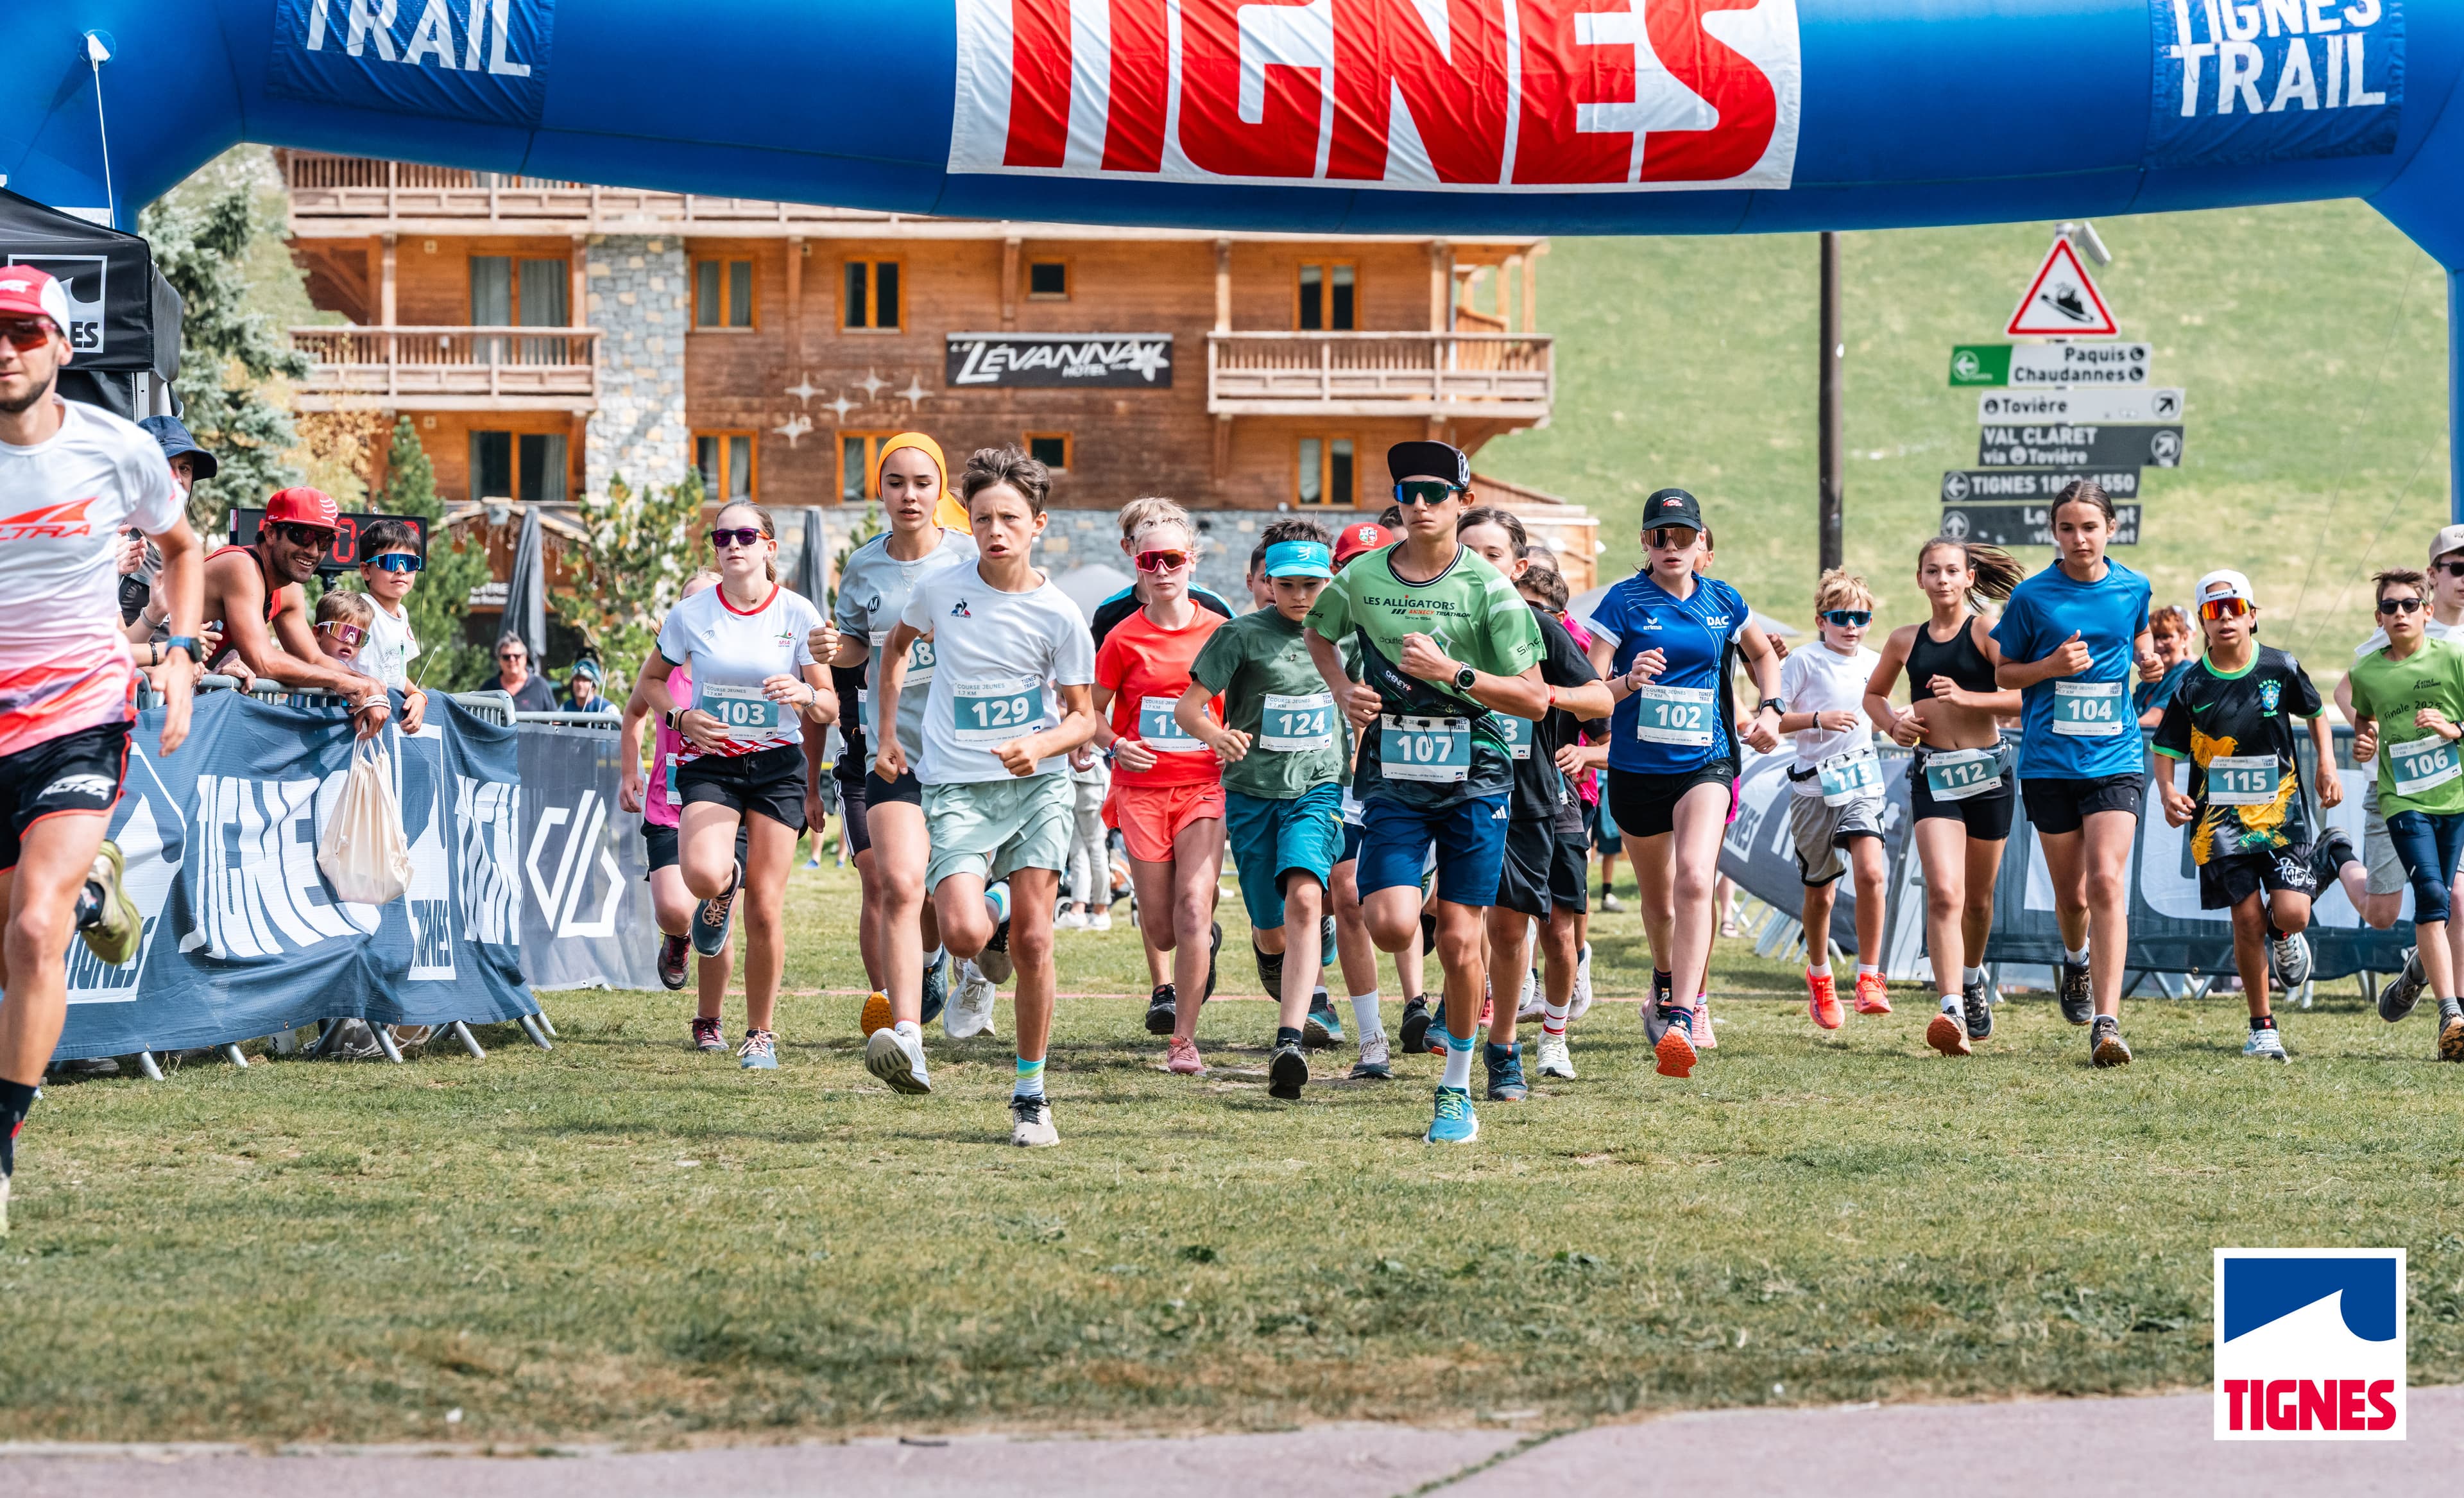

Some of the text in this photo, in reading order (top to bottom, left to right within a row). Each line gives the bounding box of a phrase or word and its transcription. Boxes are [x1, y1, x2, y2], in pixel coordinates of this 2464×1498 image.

[2170, 33, 2386, 117] TRAIL
[2064, 347, 2126, 365] Paquis
[2014, 367, 2125, 382] Chaudannes
[2003, 395, 2067, 413] Tovière
[1983, 427, 2098, 445] VAL CLARET
[1983, 447, 2088, 464] via Tovière
[1971, 476, 2037, 494] TIGNES
[0, 524, 91, 541] LTRA
[869, 598, 878, 610] M
[1363, 596, 1380, 605] LES
[1436, 610, 1471, 618] TRIATHLON
[1706, 616, 1729, 626] DAC
[1022, 675, 1037, 685] TIGNES
[717, 701, 766, 725] 103
[971, 697, 1029, 727] 129
[2067, 699, 2112, 721] 104
[2415, 700, 2444, 710] 2025
[1278, 710, 1325, 736] 124
[1656, 703, 1702, 729] 102
[1154, 714, 1191, 737] 11
[1396, 735, 1455, 762] 107
[2404, 748, 2449, 778] 106
[1833, 764, 1874, 791] 113
[1940, 762, 1987, 787] 112
[2222, 770, 2267, 791] 115
